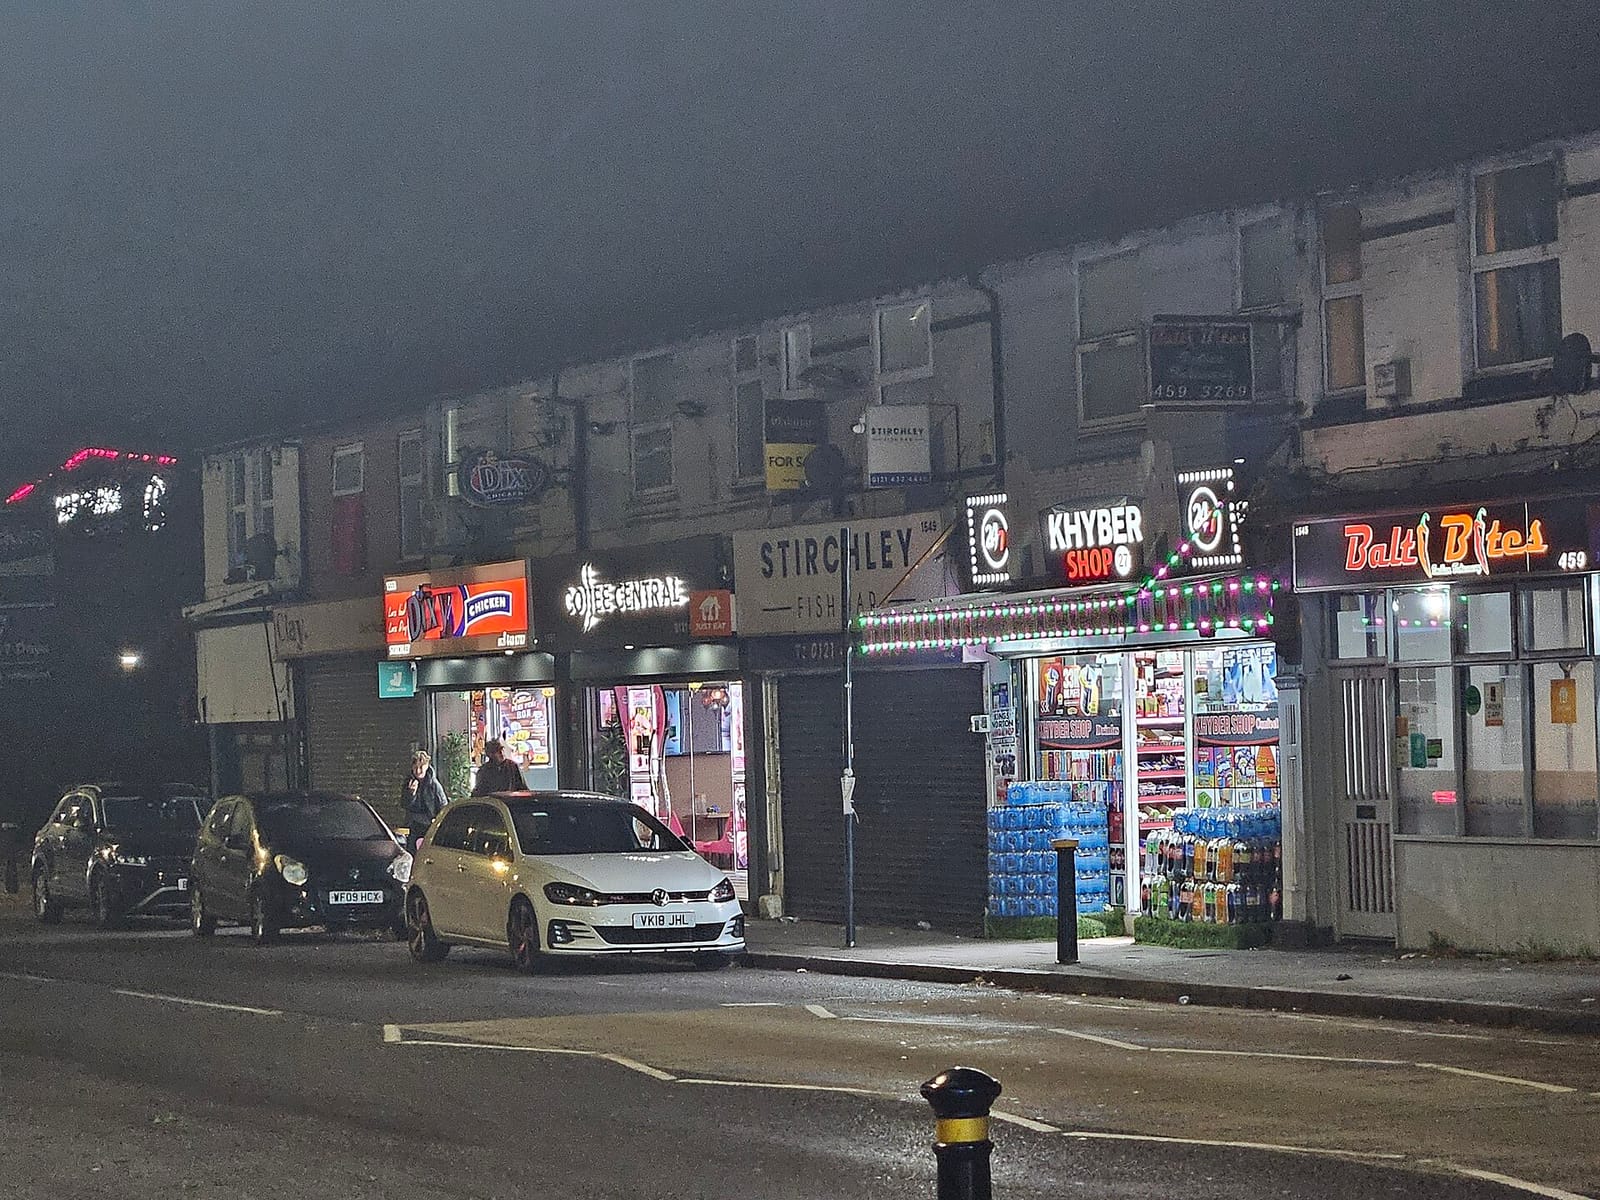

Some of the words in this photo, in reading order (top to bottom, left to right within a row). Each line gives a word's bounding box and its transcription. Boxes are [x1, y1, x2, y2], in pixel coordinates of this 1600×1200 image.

[871, 427, 925, 436] STIRCHLEY
[768, 456, 794, 468] FOR
[1048, 505, 1143, 551] KHYBER
[759, 528, 913, 579] STIRCHLEY
[1066, 547, 1114, 579] SHOP
[1556, 551, 1587, 571] 459
[616, 577, 686, 613] CENTRAL
[469, 595, 507, 617] CHICKEN
[797, 594, 836, 619] FISH
[695, 622, 711, 631] JUST
[712, 622, 727, 632] EAT
[811, 642, 835, 658] 0121
[1039, 720, 1070, 739] KHYBER
[1070, 719, 1092, 738] SHOP
[1196, 715, 1231, 735] KHYBER
[1231, 714, 1256, 735] SHOP
[360, 891, 379, 902] HCX
[640, 914, 666, 927] VK18
[668, 913, 689, 926] JHL
